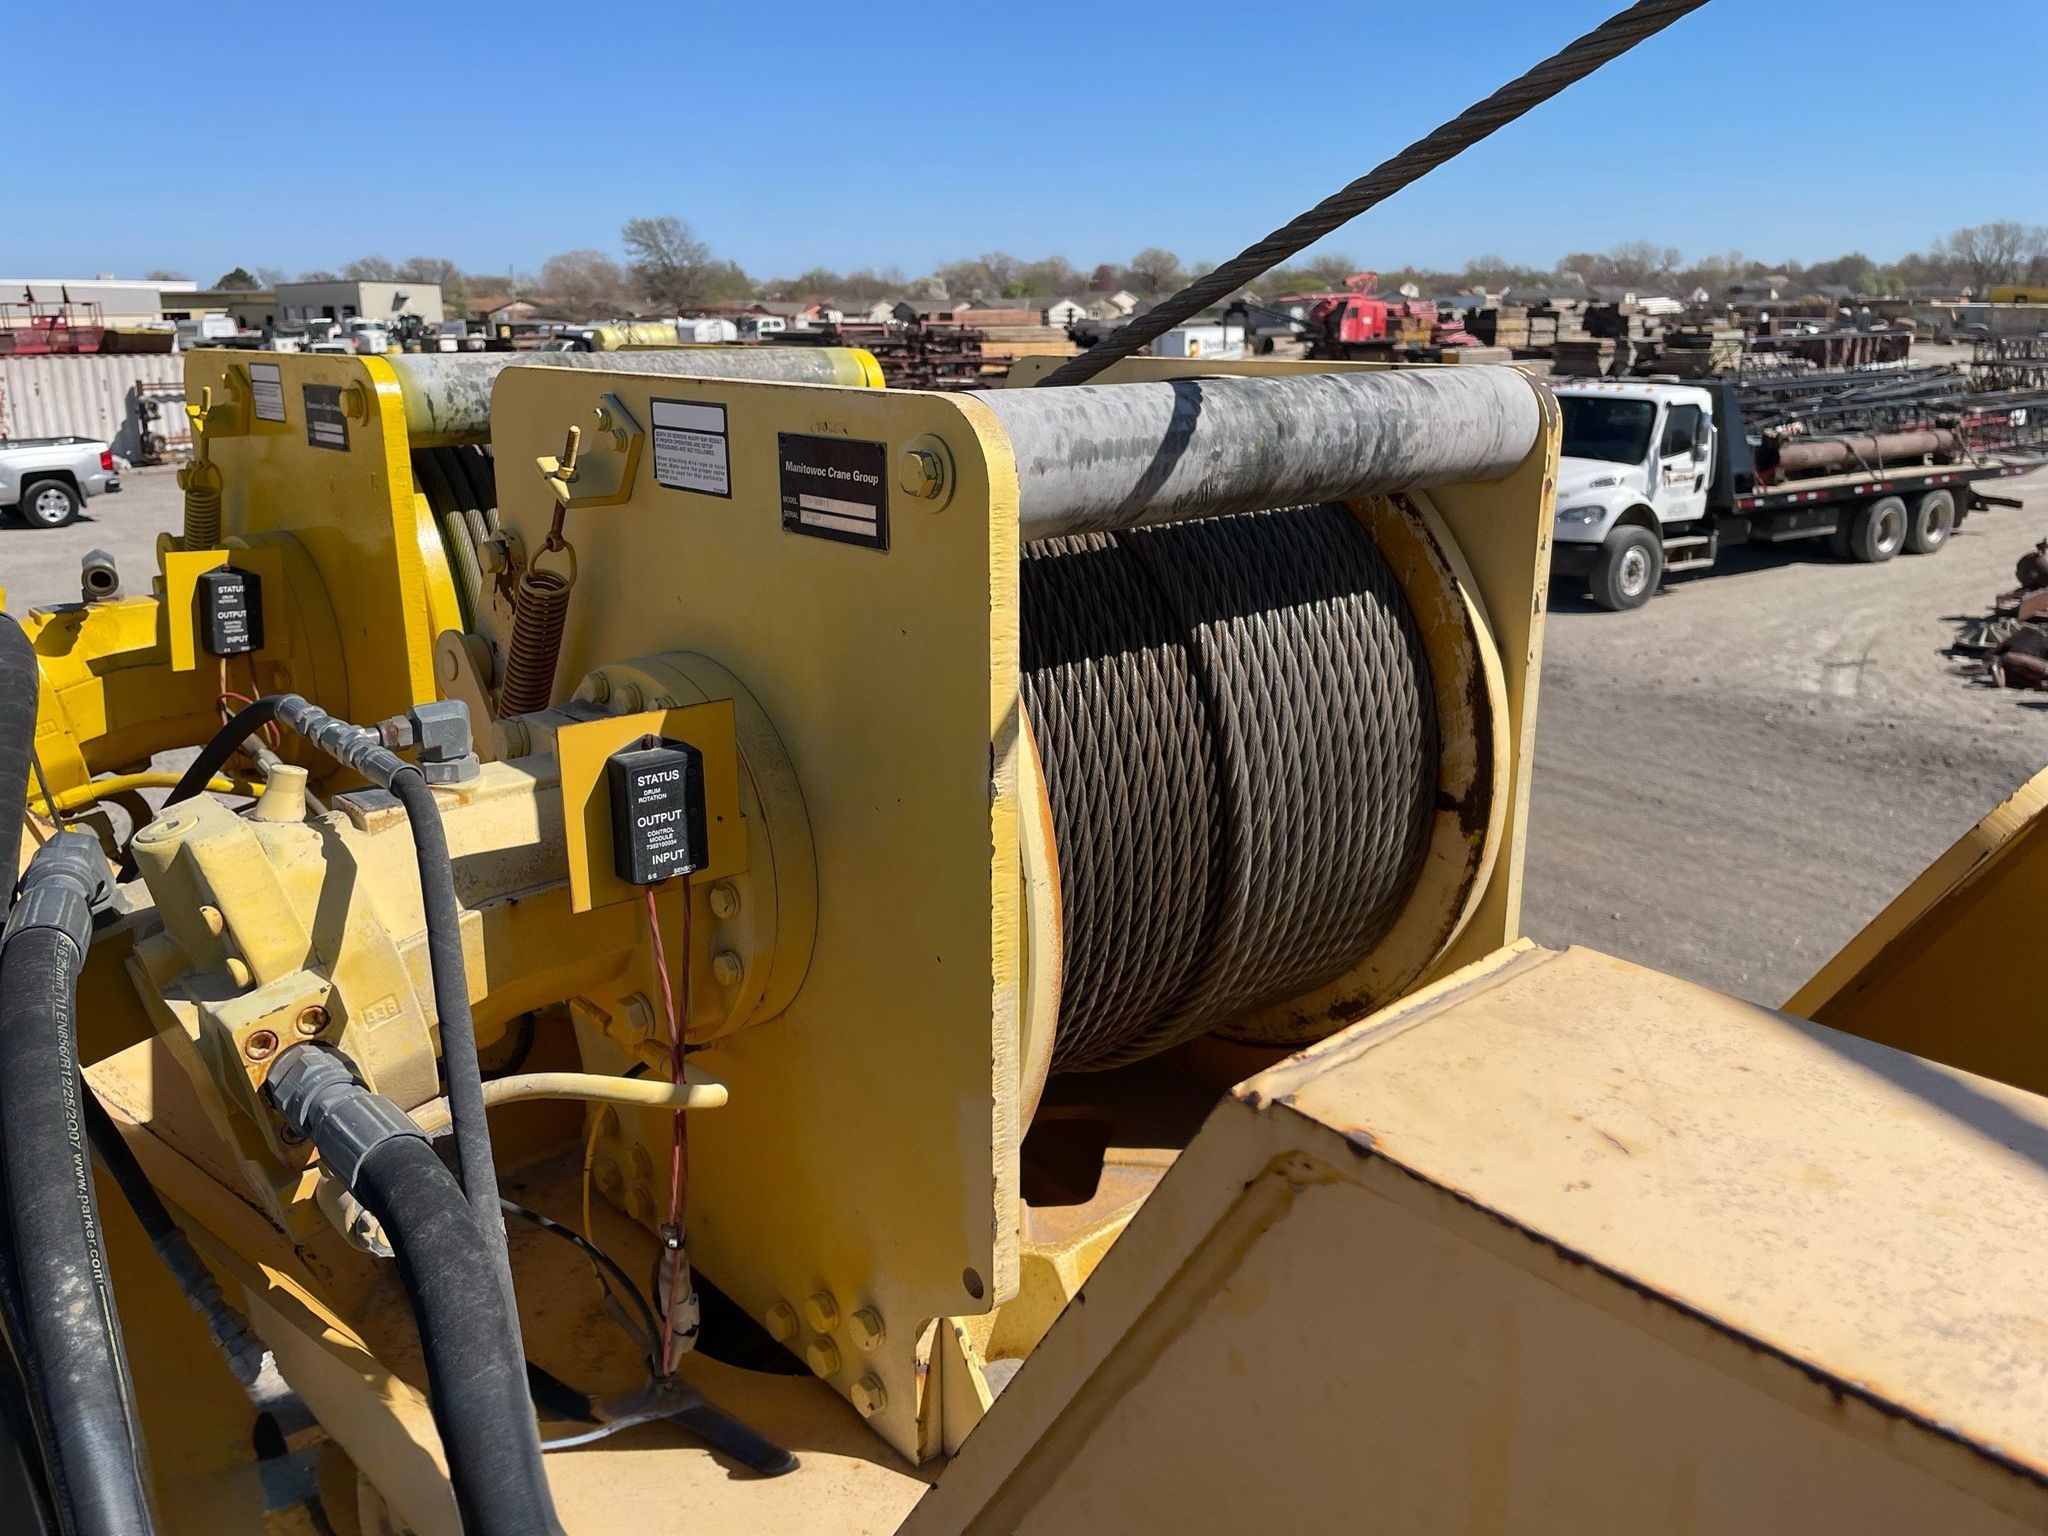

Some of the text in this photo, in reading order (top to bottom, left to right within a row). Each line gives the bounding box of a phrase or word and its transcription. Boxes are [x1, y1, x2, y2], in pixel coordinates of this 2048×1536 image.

[785, 461, 879, 486] Manitowoc Crane Group
[218, 610, 247, 619] OUTPUT
[226, 635, 249, 644] INPUT
[638, 769, 680, 787] STATUS
[644, 787, 661, 796] DRUM
[638, 792, 667, 804] ROTATION
[637, 809, 682, 828] OUTPUT
[647, 827, 675, 838] CONTROL
[649, 834, 674, 843] MODULE
[652, 848, 685, 865] INPUT
[73, 1153, 104, 1284] www.parker.com
